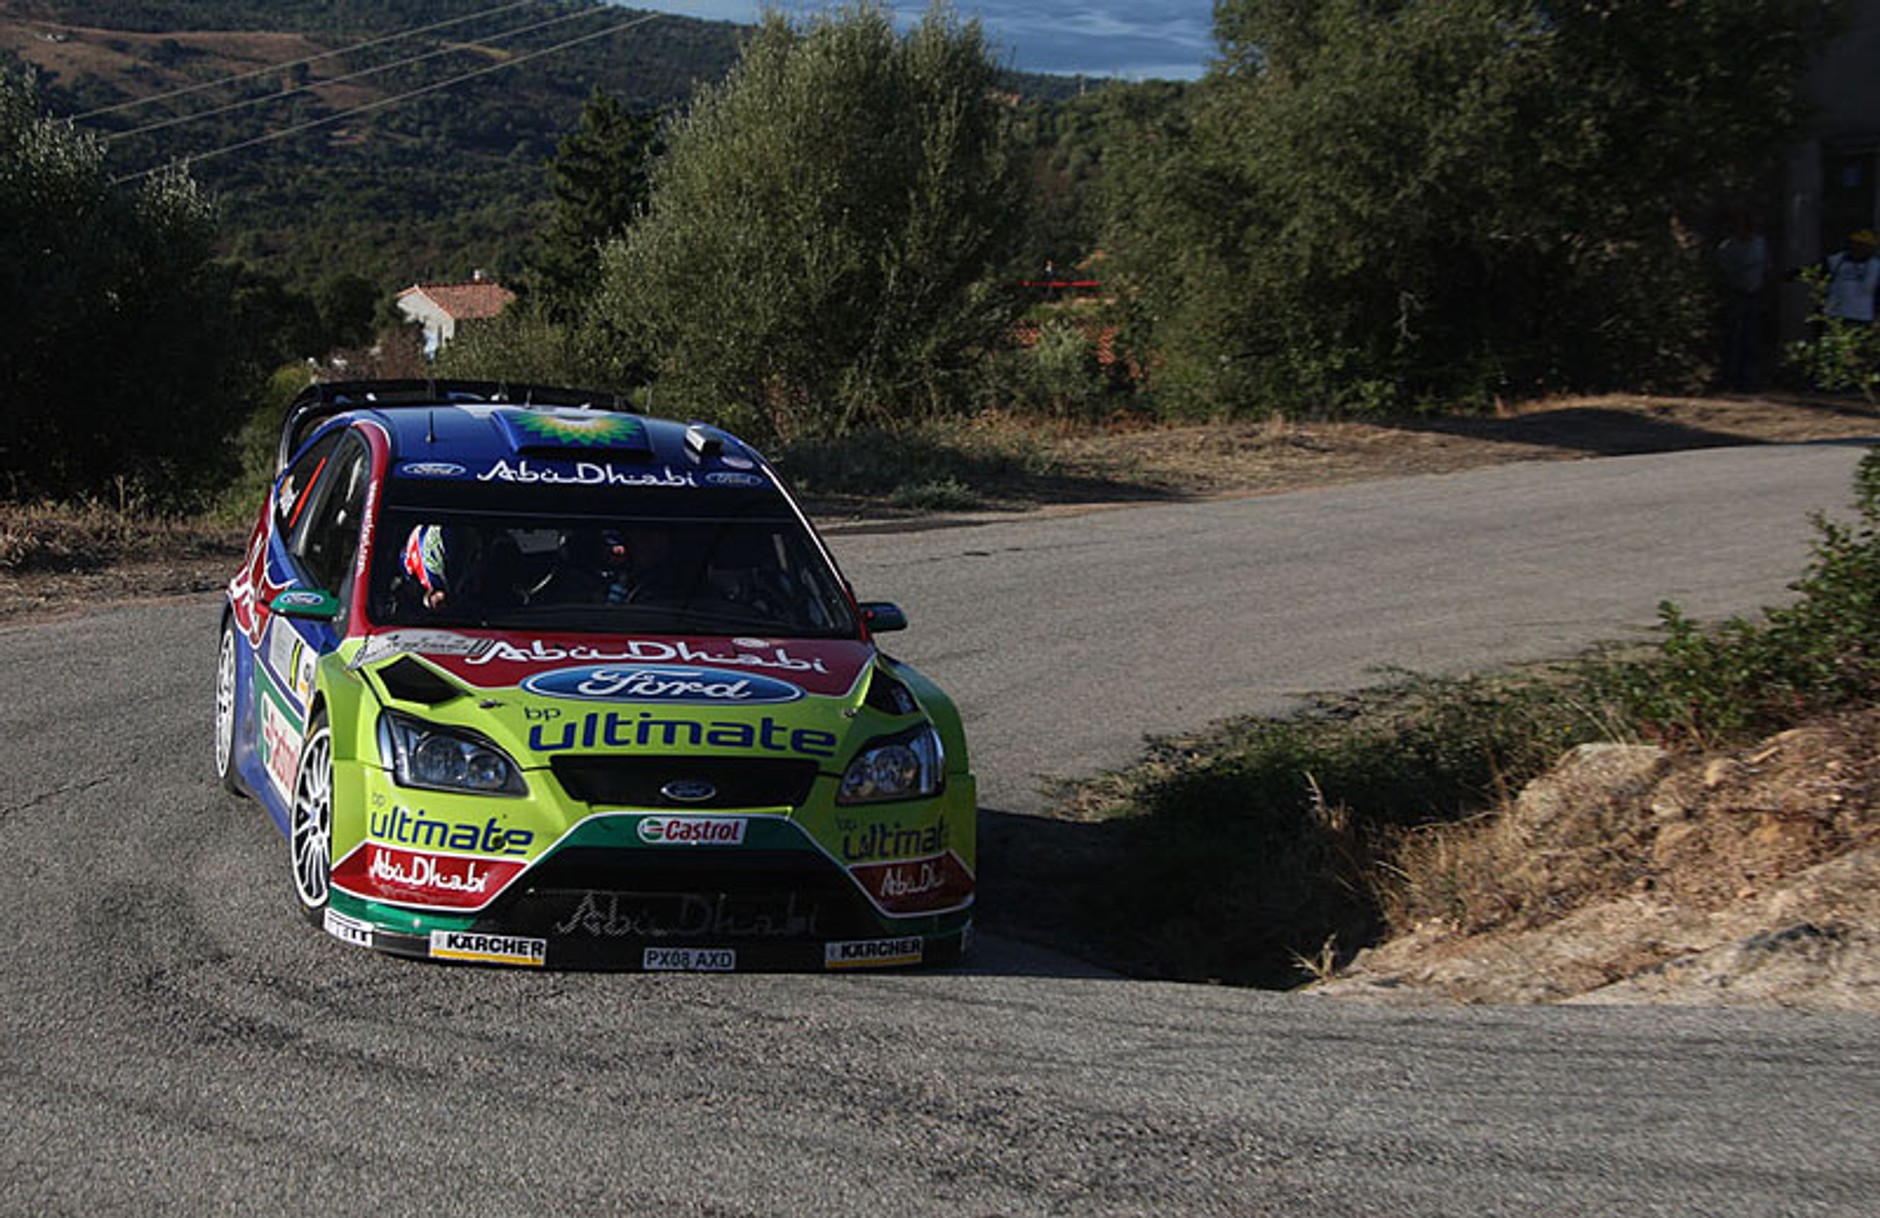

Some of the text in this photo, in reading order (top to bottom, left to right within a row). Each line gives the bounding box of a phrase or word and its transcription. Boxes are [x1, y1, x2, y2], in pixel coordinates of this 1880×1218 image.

[577, 669, 753, 698] Ford
[524, 706, 562, 721] bp
[529, 711, 838, 758] ultimate
[370, 805, 535, 855] ultimate
[664, 819, 741, 841] Castrol
[646, 950, 733, 969] PX08 AXD
